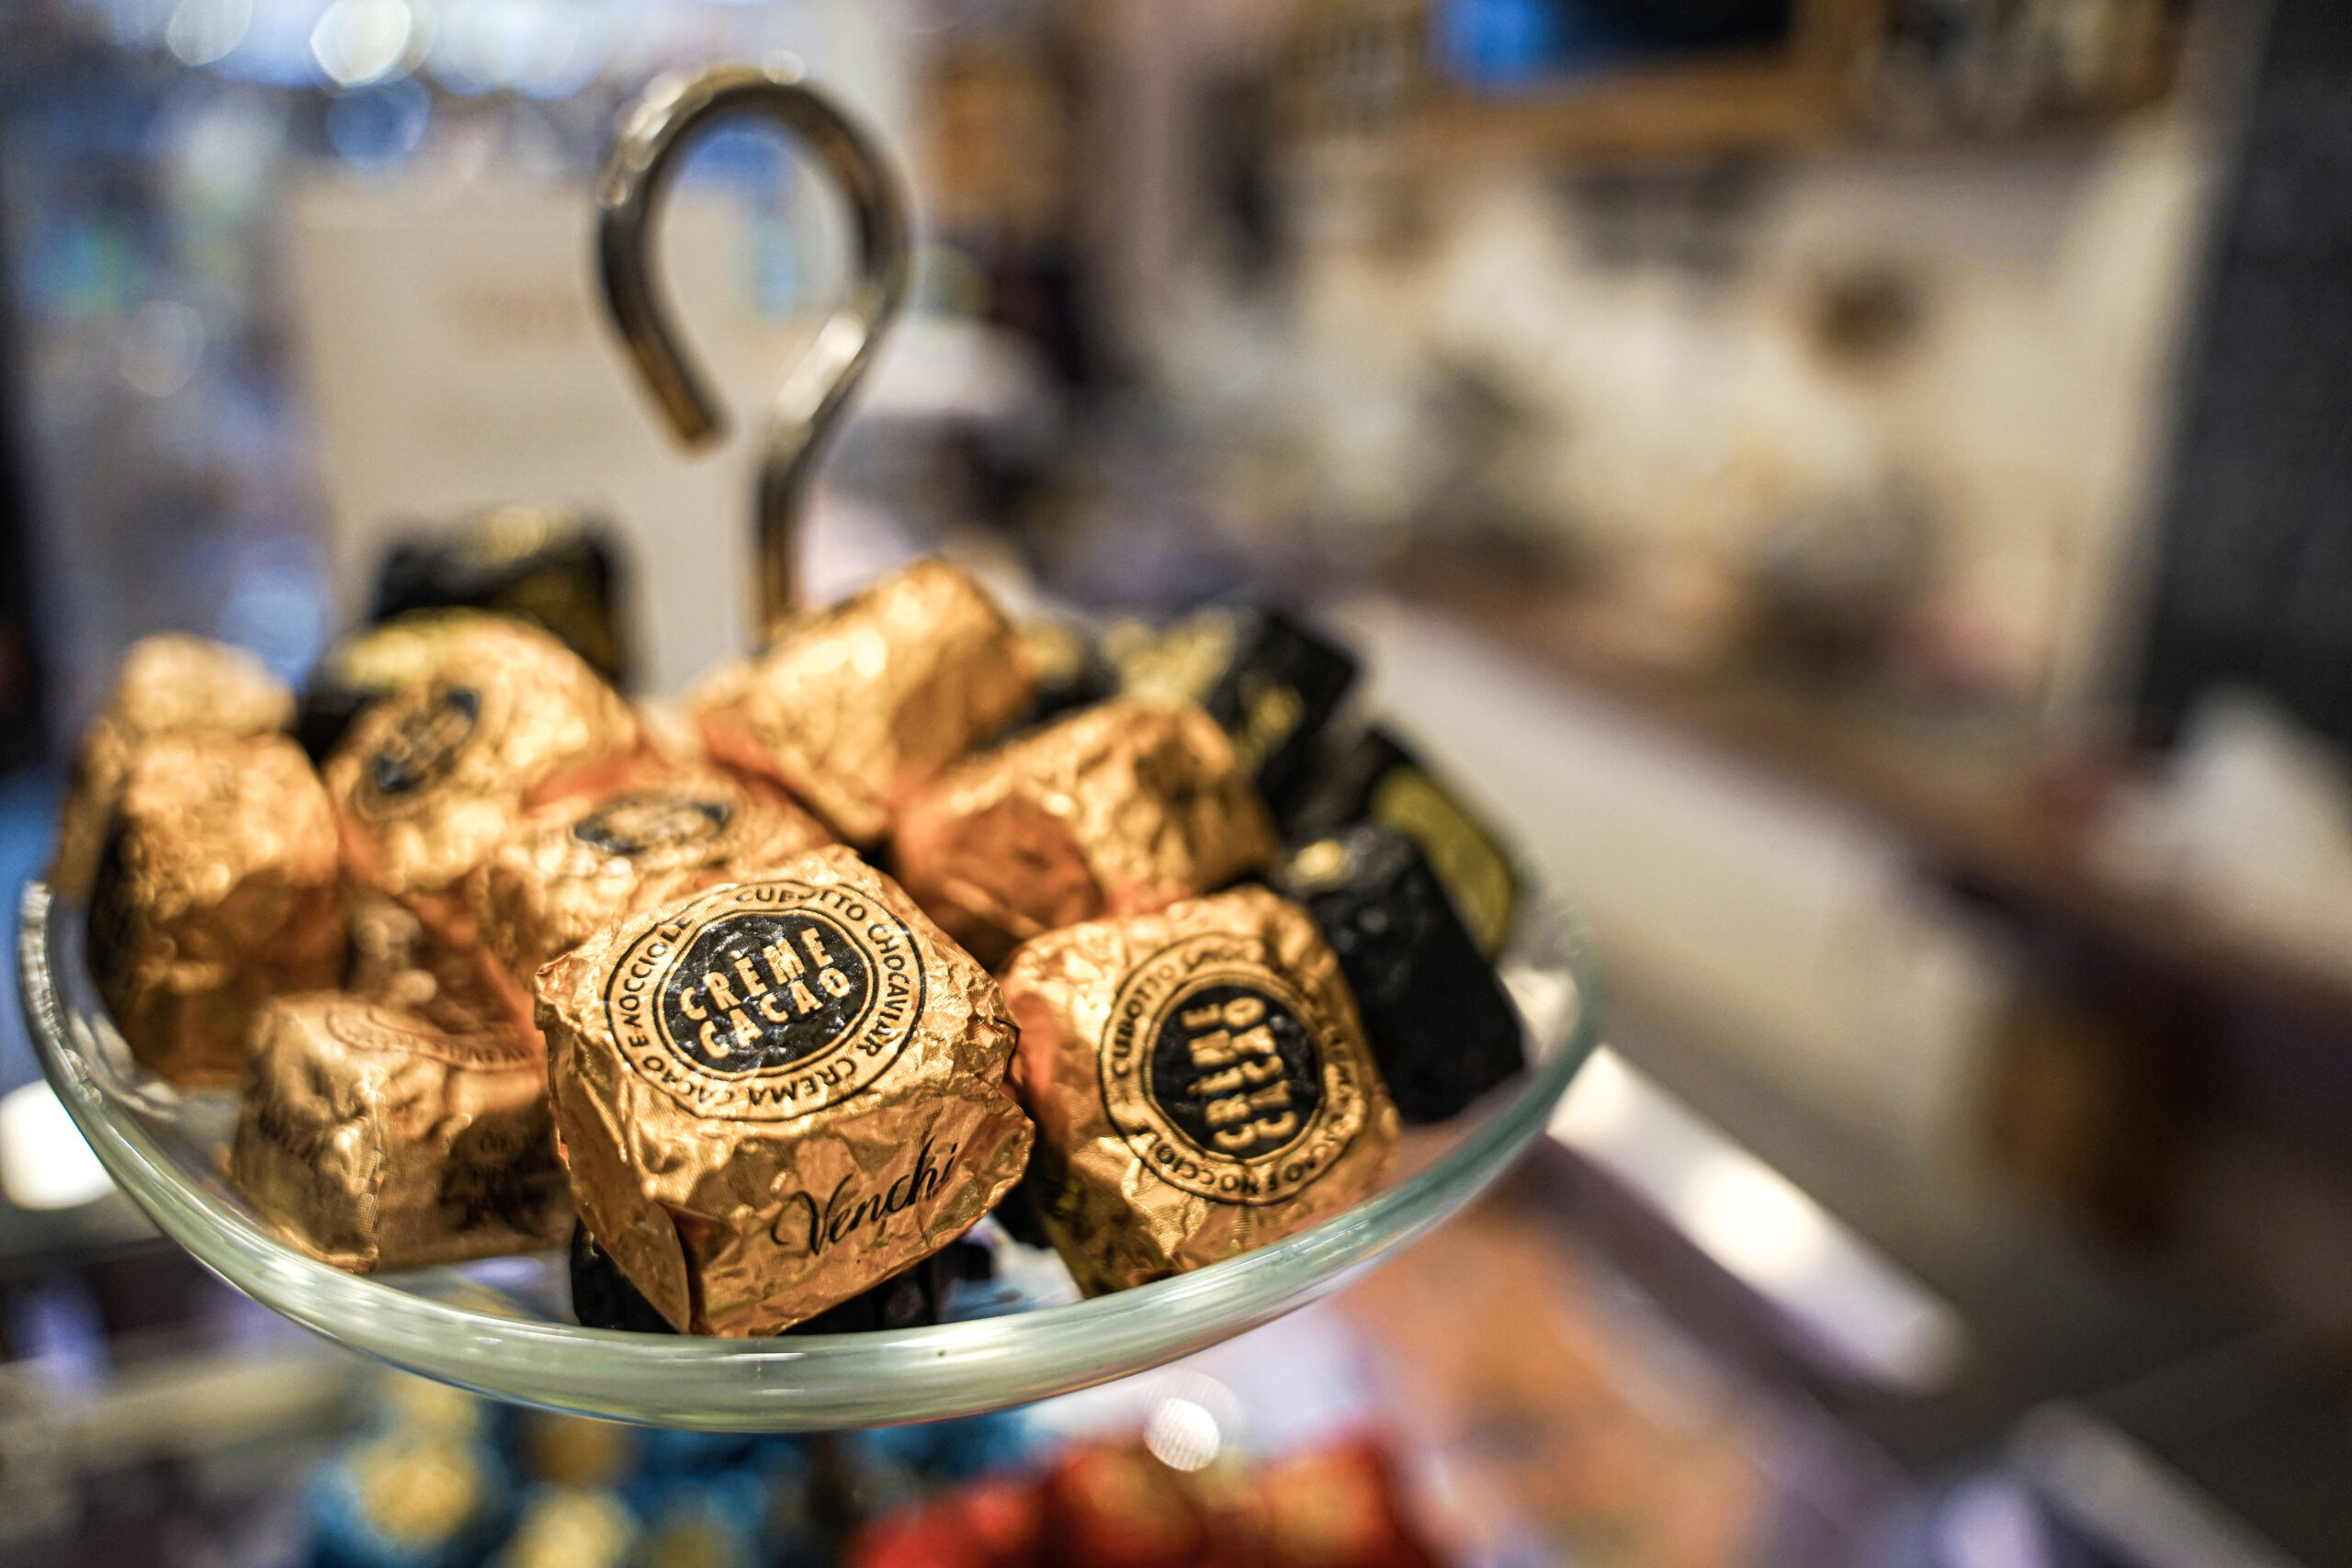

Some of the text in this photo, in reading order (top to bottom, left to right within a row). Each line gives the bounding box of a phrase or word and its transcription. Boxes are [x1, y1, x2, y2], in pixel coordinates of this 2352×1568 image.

[618, 918, 693, 1029] NOCCIOLE
[679, 927, 834, 1021] CRÈME
[698, 967, 851, 1059] CACAO
[856, 922, 910, 1056] CHOCAVIAR
[628, 1034, 650, 1048] E
[747, 1057, 858, 1106] CREMA
[1223, 997, 1298, 1139] CACAO
[771, 1134, 958, 1257] Venchi
